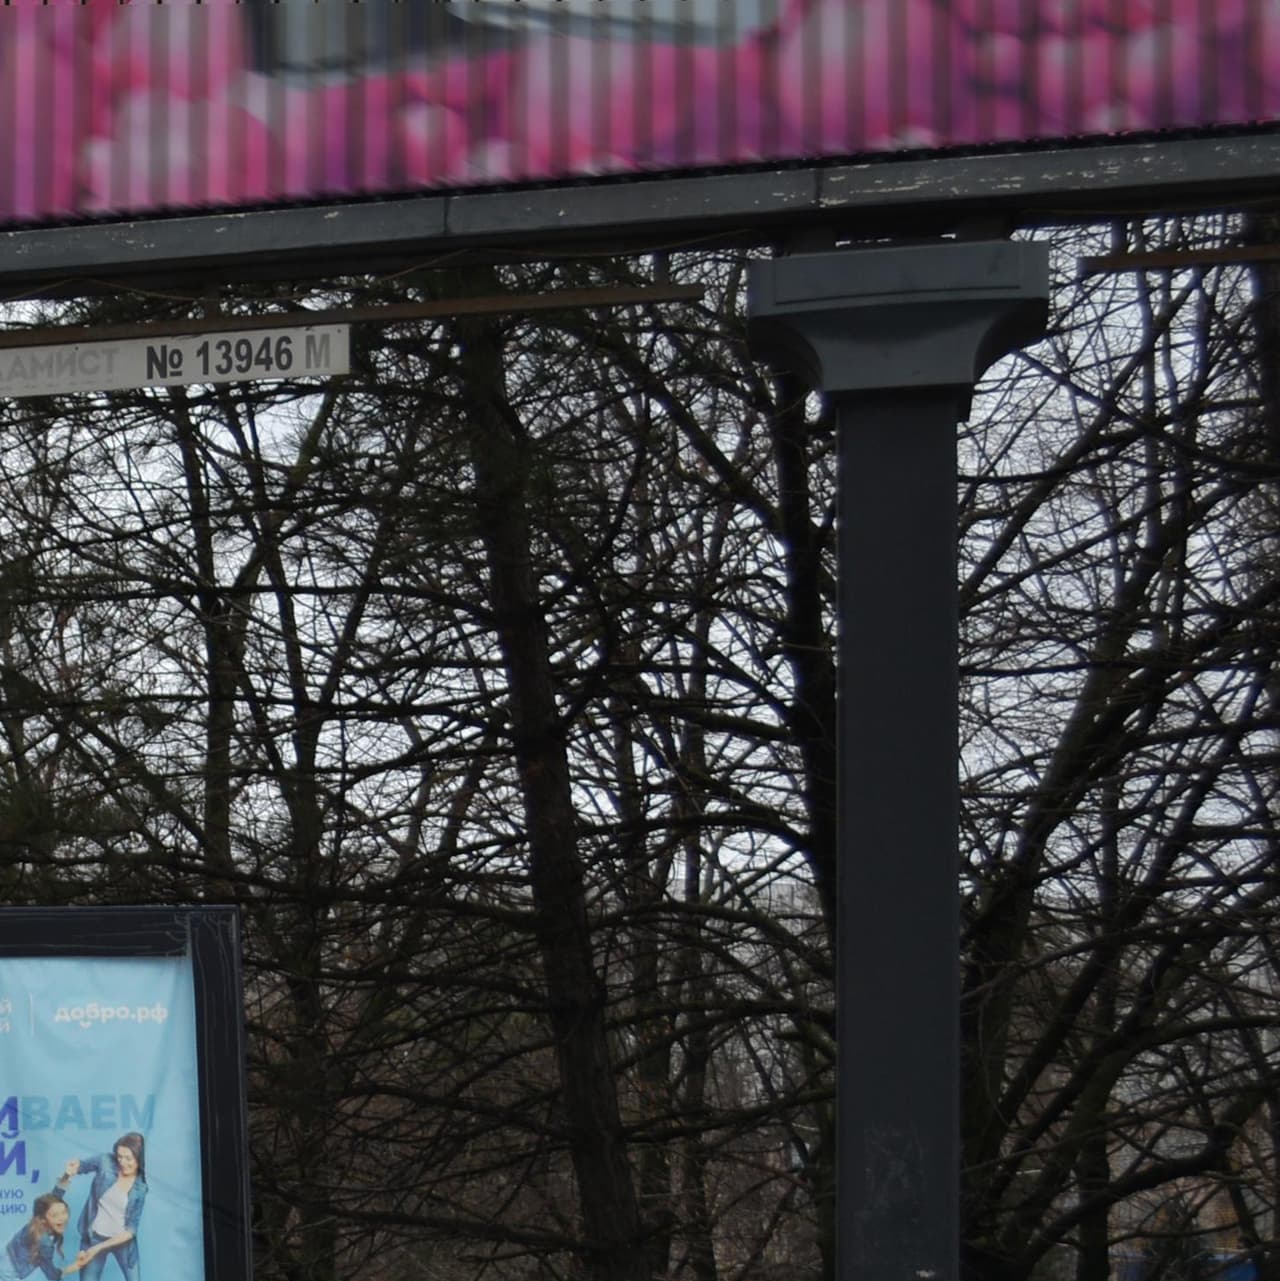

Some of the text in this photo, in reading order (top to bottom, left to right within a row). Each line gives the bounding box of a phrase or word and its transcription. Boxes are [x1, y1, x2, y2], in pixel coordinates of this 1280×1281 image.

[146, 345, 183, 379] №
[197, 336, 293, 375] 13946
[54, 1002, 169, 1028] добро.рф
